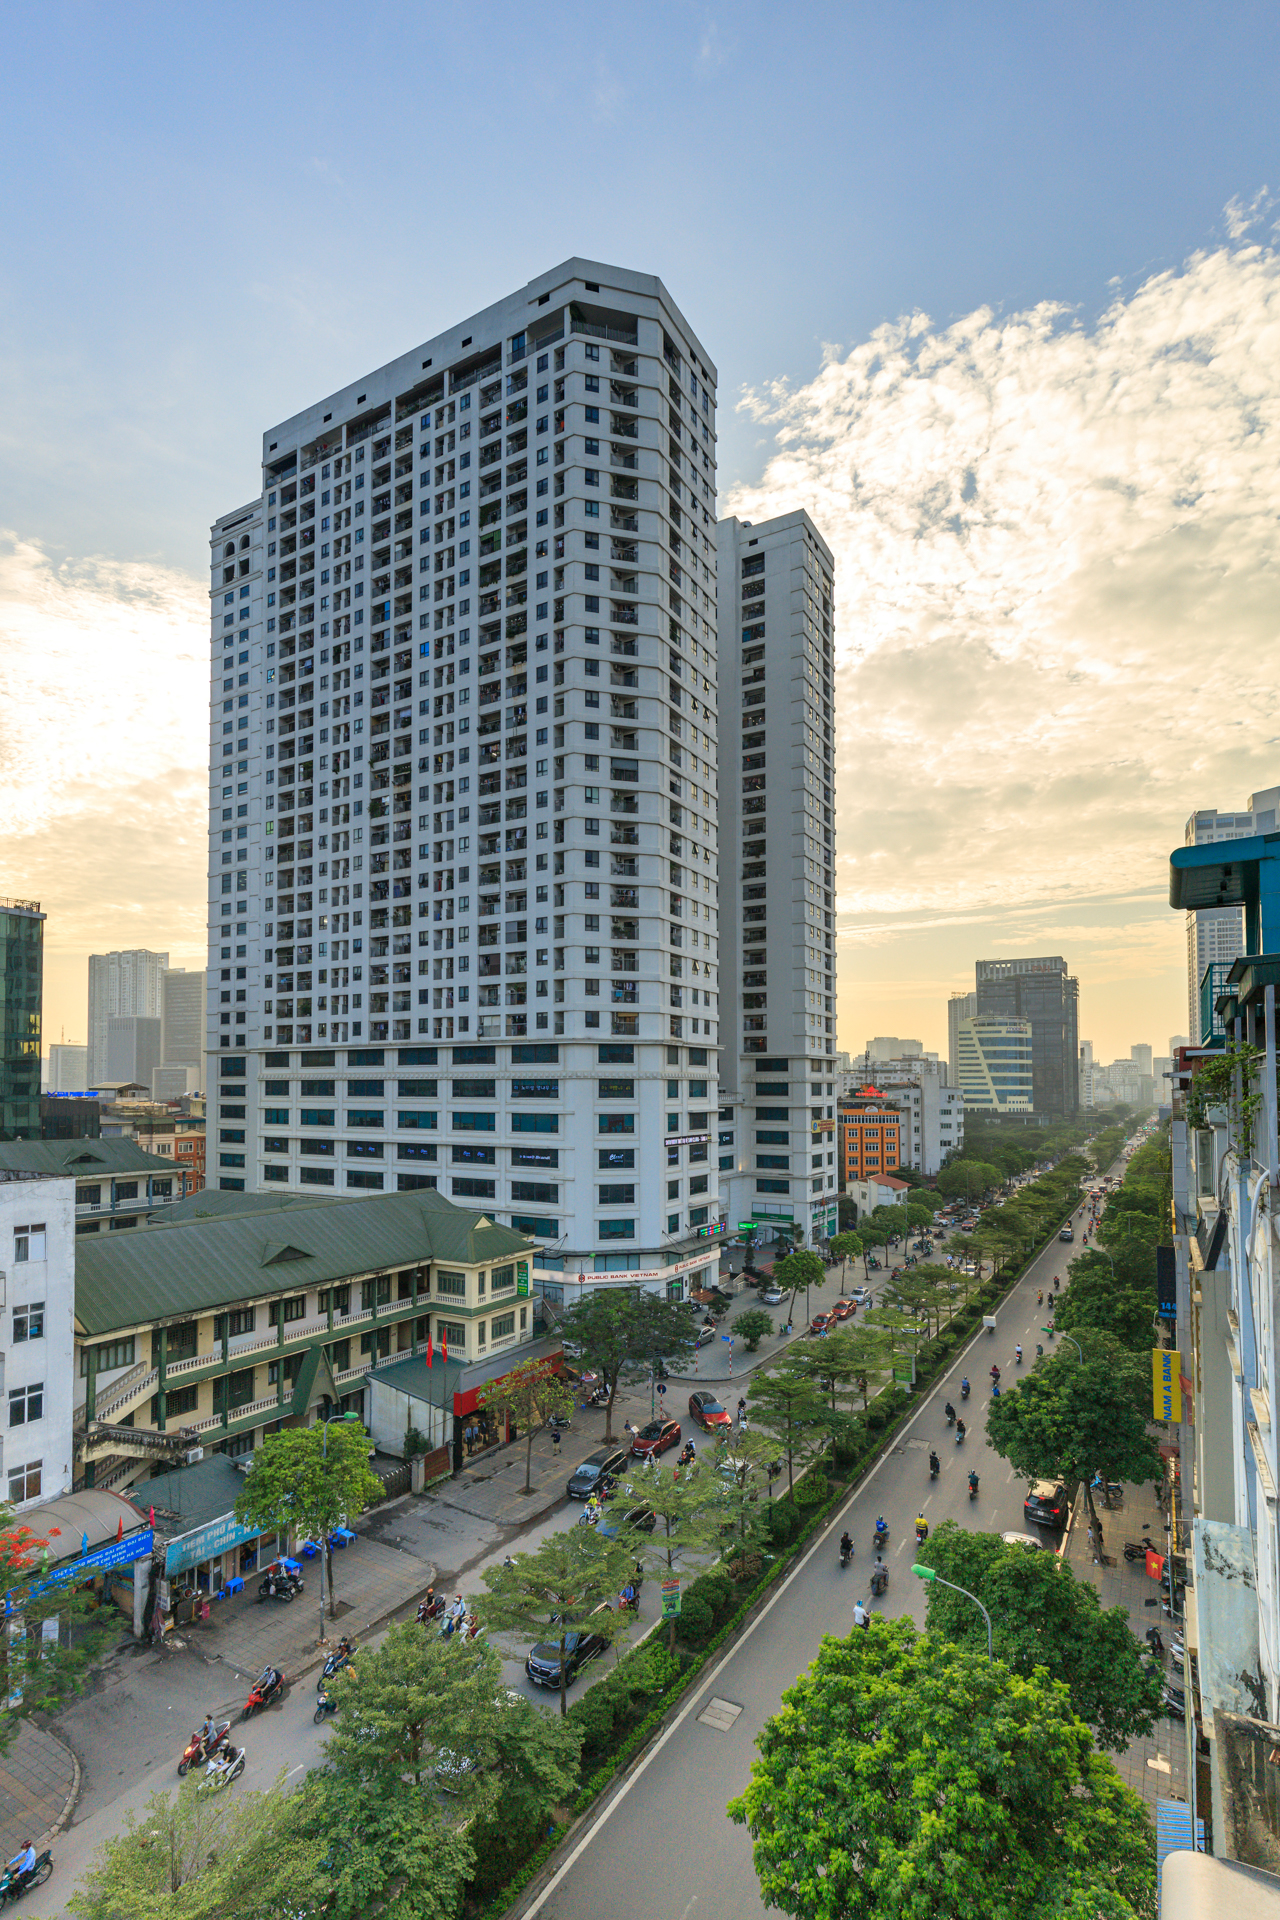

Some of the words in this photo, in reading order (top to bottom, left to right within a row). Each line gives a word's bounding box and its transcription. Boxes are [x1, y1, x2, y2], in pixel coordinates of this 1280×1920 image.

[1161, 1302, 1176, 1310] 144
[1162, 1352, 1172, 1382] BANK
[1163, 1385, 1172, 1393] A
[1164, 1395, 1172, 1420] NAM
